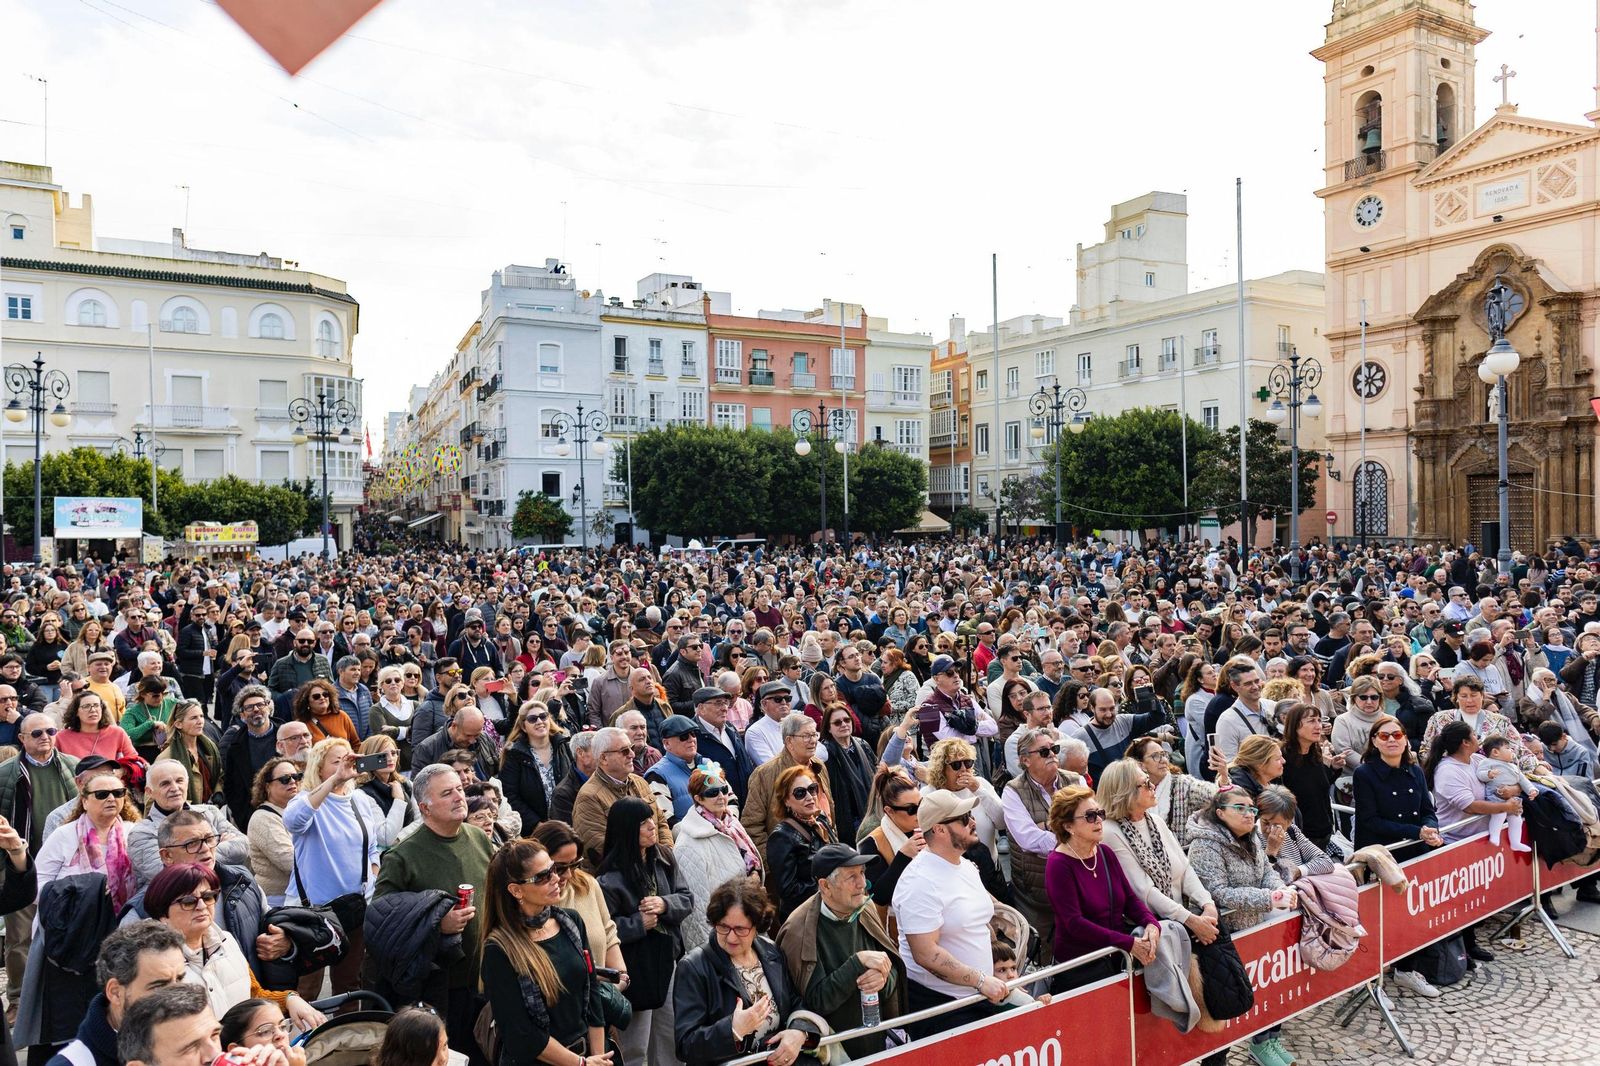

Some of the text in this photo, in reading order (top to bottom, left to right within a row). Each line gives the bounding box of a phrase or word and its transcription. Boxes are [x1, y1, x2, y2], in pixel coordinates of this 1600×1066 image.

[1485, 184, 1518, 196] RENOVADA
[1406, 852, 1505, 916] Cruzcampo
[1428, 895, 1486, 929] DESDE 1904
[1279, 982, 1310, 1005] 1904
